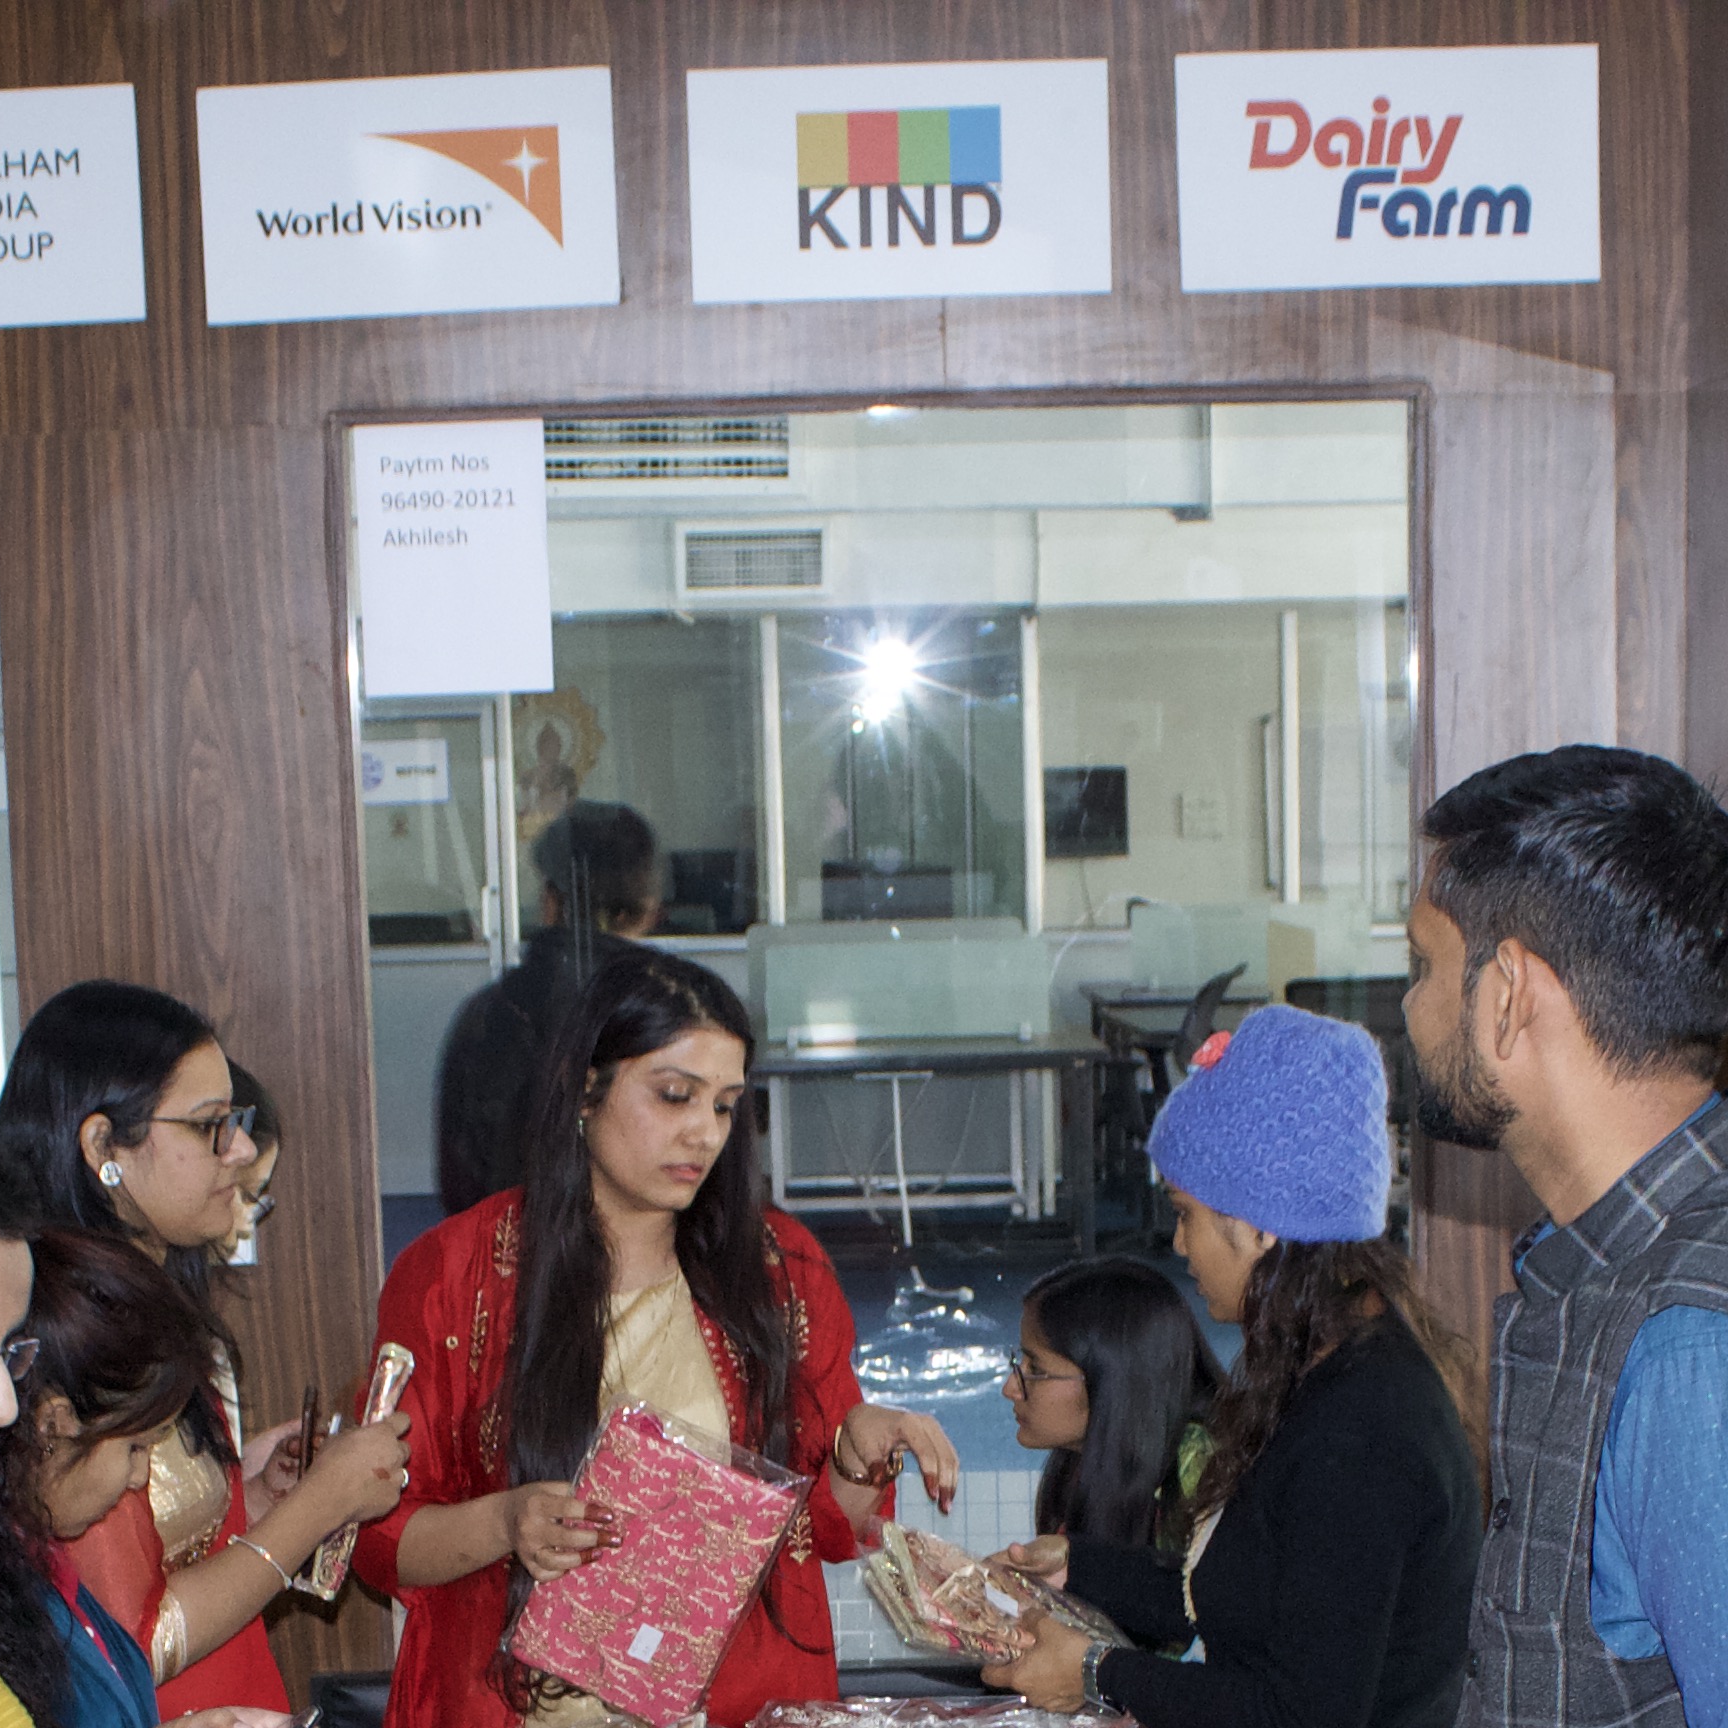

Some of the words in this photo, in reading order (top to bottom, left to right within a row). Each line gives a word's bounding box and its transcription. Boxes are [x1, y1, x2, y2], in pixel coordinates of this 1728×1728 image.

[1246, 96, 1464, 184] Dairy
[256, 200, 364, 238] World
[372, 198, 482, 232] Vision
[799, 183, 1002, 250] KIND
[1336, 167, 1532, 240] Farm
[380, 455, 444, 479] Paytm
[452, 453, 490, 472] Nos
[381, 488, 515, 512] 96490-20121
[383, 526, 469, 547] Akhilesh
